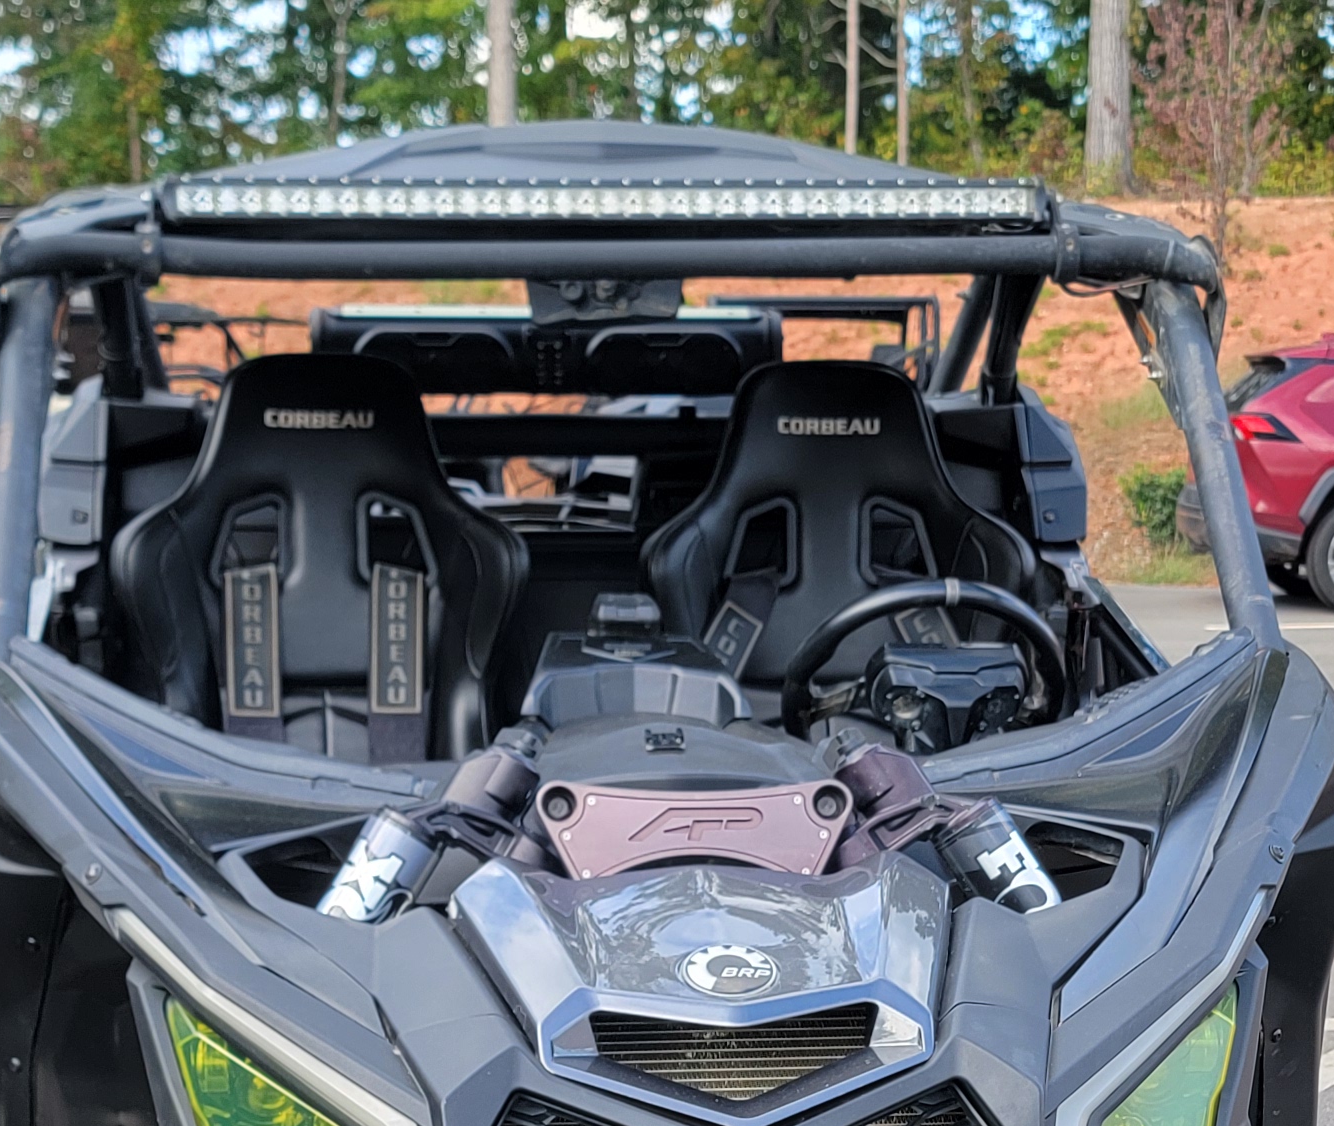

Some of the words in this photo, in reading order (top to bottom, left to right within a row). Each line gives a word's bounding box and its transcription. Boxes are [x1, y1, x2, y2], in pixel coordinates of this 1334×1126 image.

[263, 407, 375, 429] CORBEAU
[777, 415, 881, 436] CORBEAU
[240, 570, 265, 708] ORBEAU
[386, 568, 408, 704] ORBEAU
[976, 829, 1063, 915] FO
[720, 966, 772, 979] BRP
